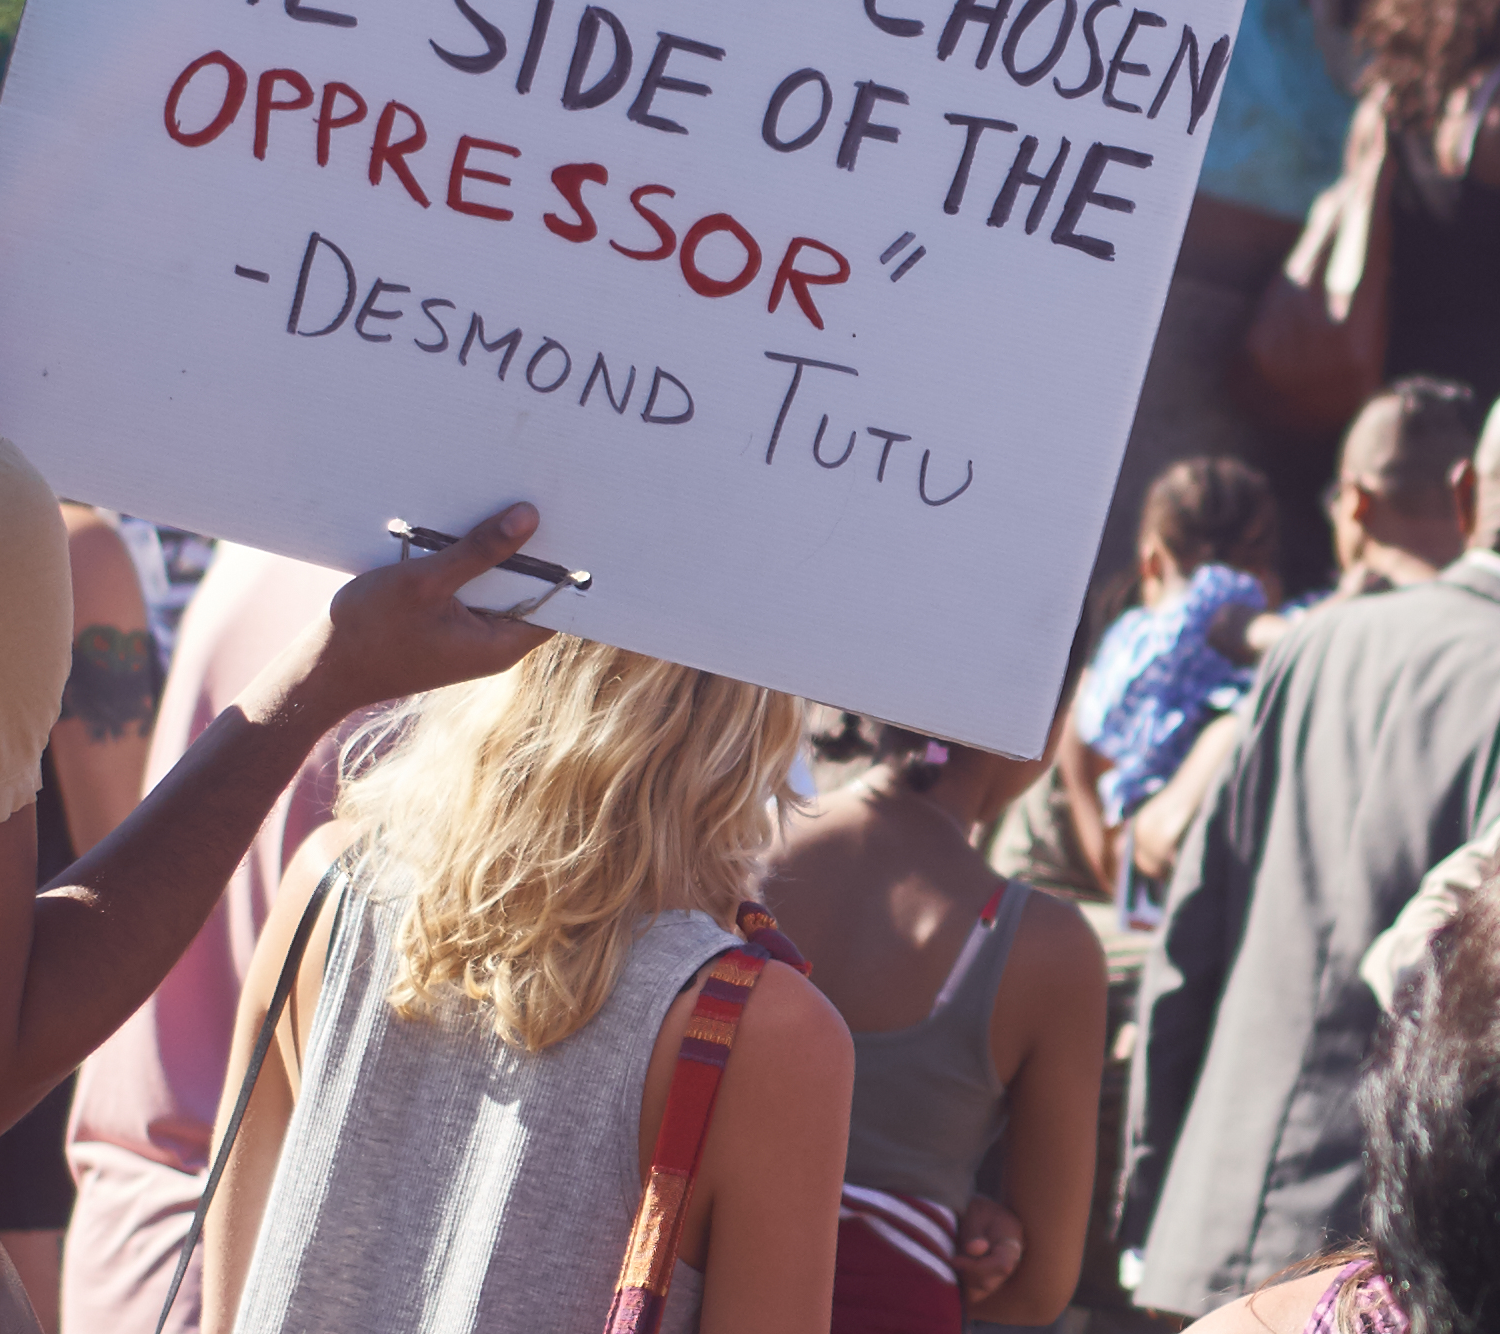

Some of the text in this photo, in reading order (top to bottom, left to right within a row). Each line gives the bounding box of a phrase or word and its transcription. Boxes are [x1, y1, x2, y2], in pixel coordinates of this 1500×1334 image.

[162, 49, 927, 330] OPPRESSOR"
[761, 66, 909, 171] OF
[941, 113, 1154, 262] THE
[764, 351, 975, 507] TUTU
